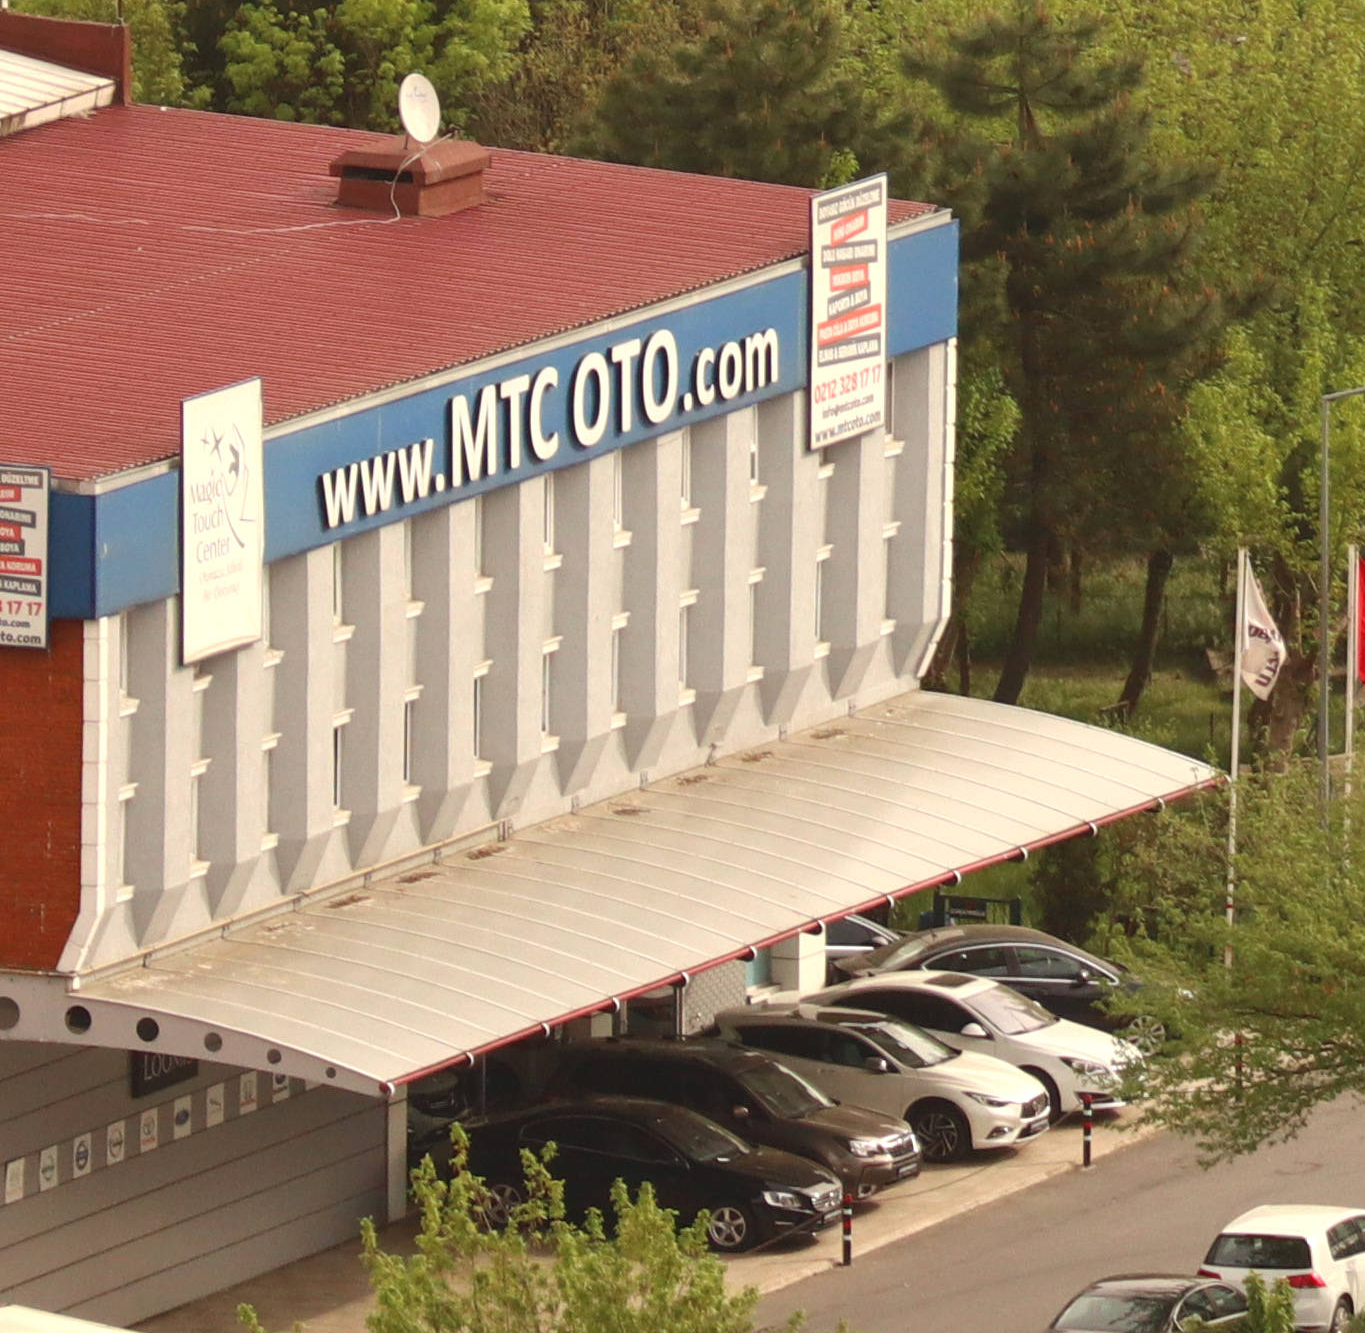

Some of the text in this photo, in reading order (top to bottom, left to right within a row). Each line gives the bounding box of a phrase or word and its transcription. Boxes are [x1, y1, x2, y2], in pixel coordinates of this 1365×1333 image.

[814, 363, 882, 405] 0212 328 17 17
[190, 469, 222, 505] Magic
[192, 505, 225, 535] Touch
[196, 536, 232, 565] Center
[7, 600, 42, 616] 17 17
